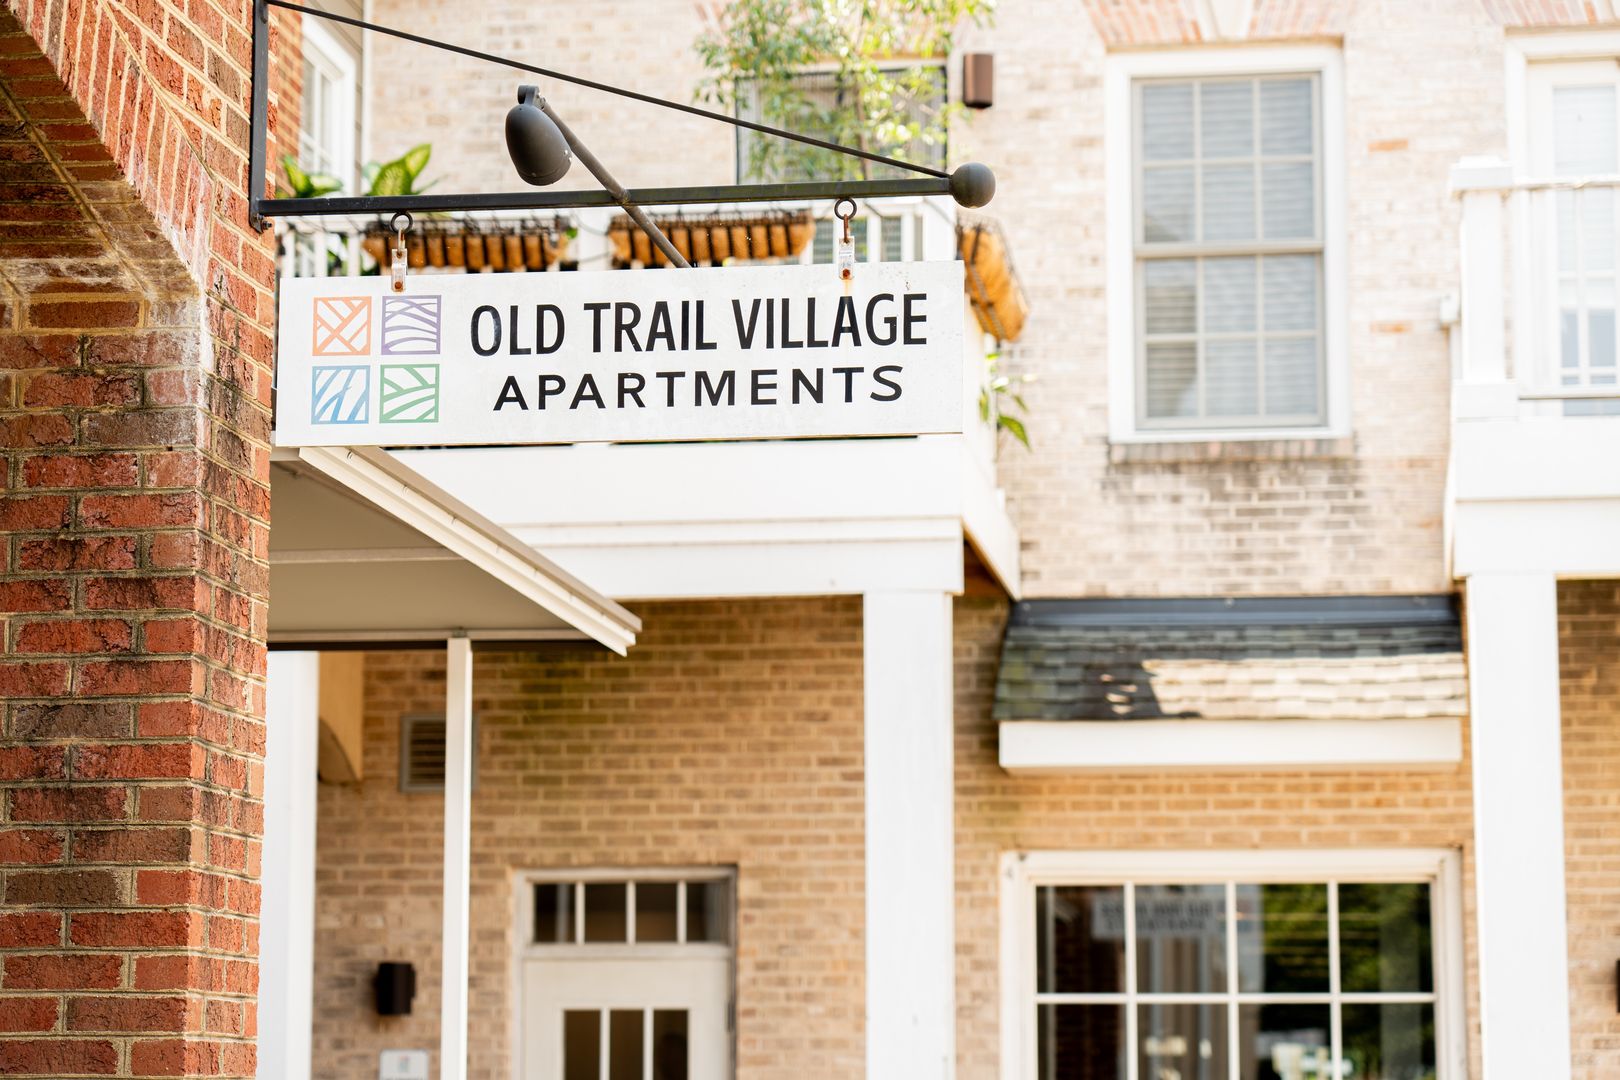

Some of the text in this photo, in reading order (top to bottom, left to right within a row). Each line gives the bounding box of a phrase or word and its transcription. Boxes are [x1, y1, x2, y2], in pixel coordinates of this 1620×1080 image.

[471, 293, 927, 357] OLD TRAIL VILLAGE
[493, 365, 903, 411] APARTMENTS
